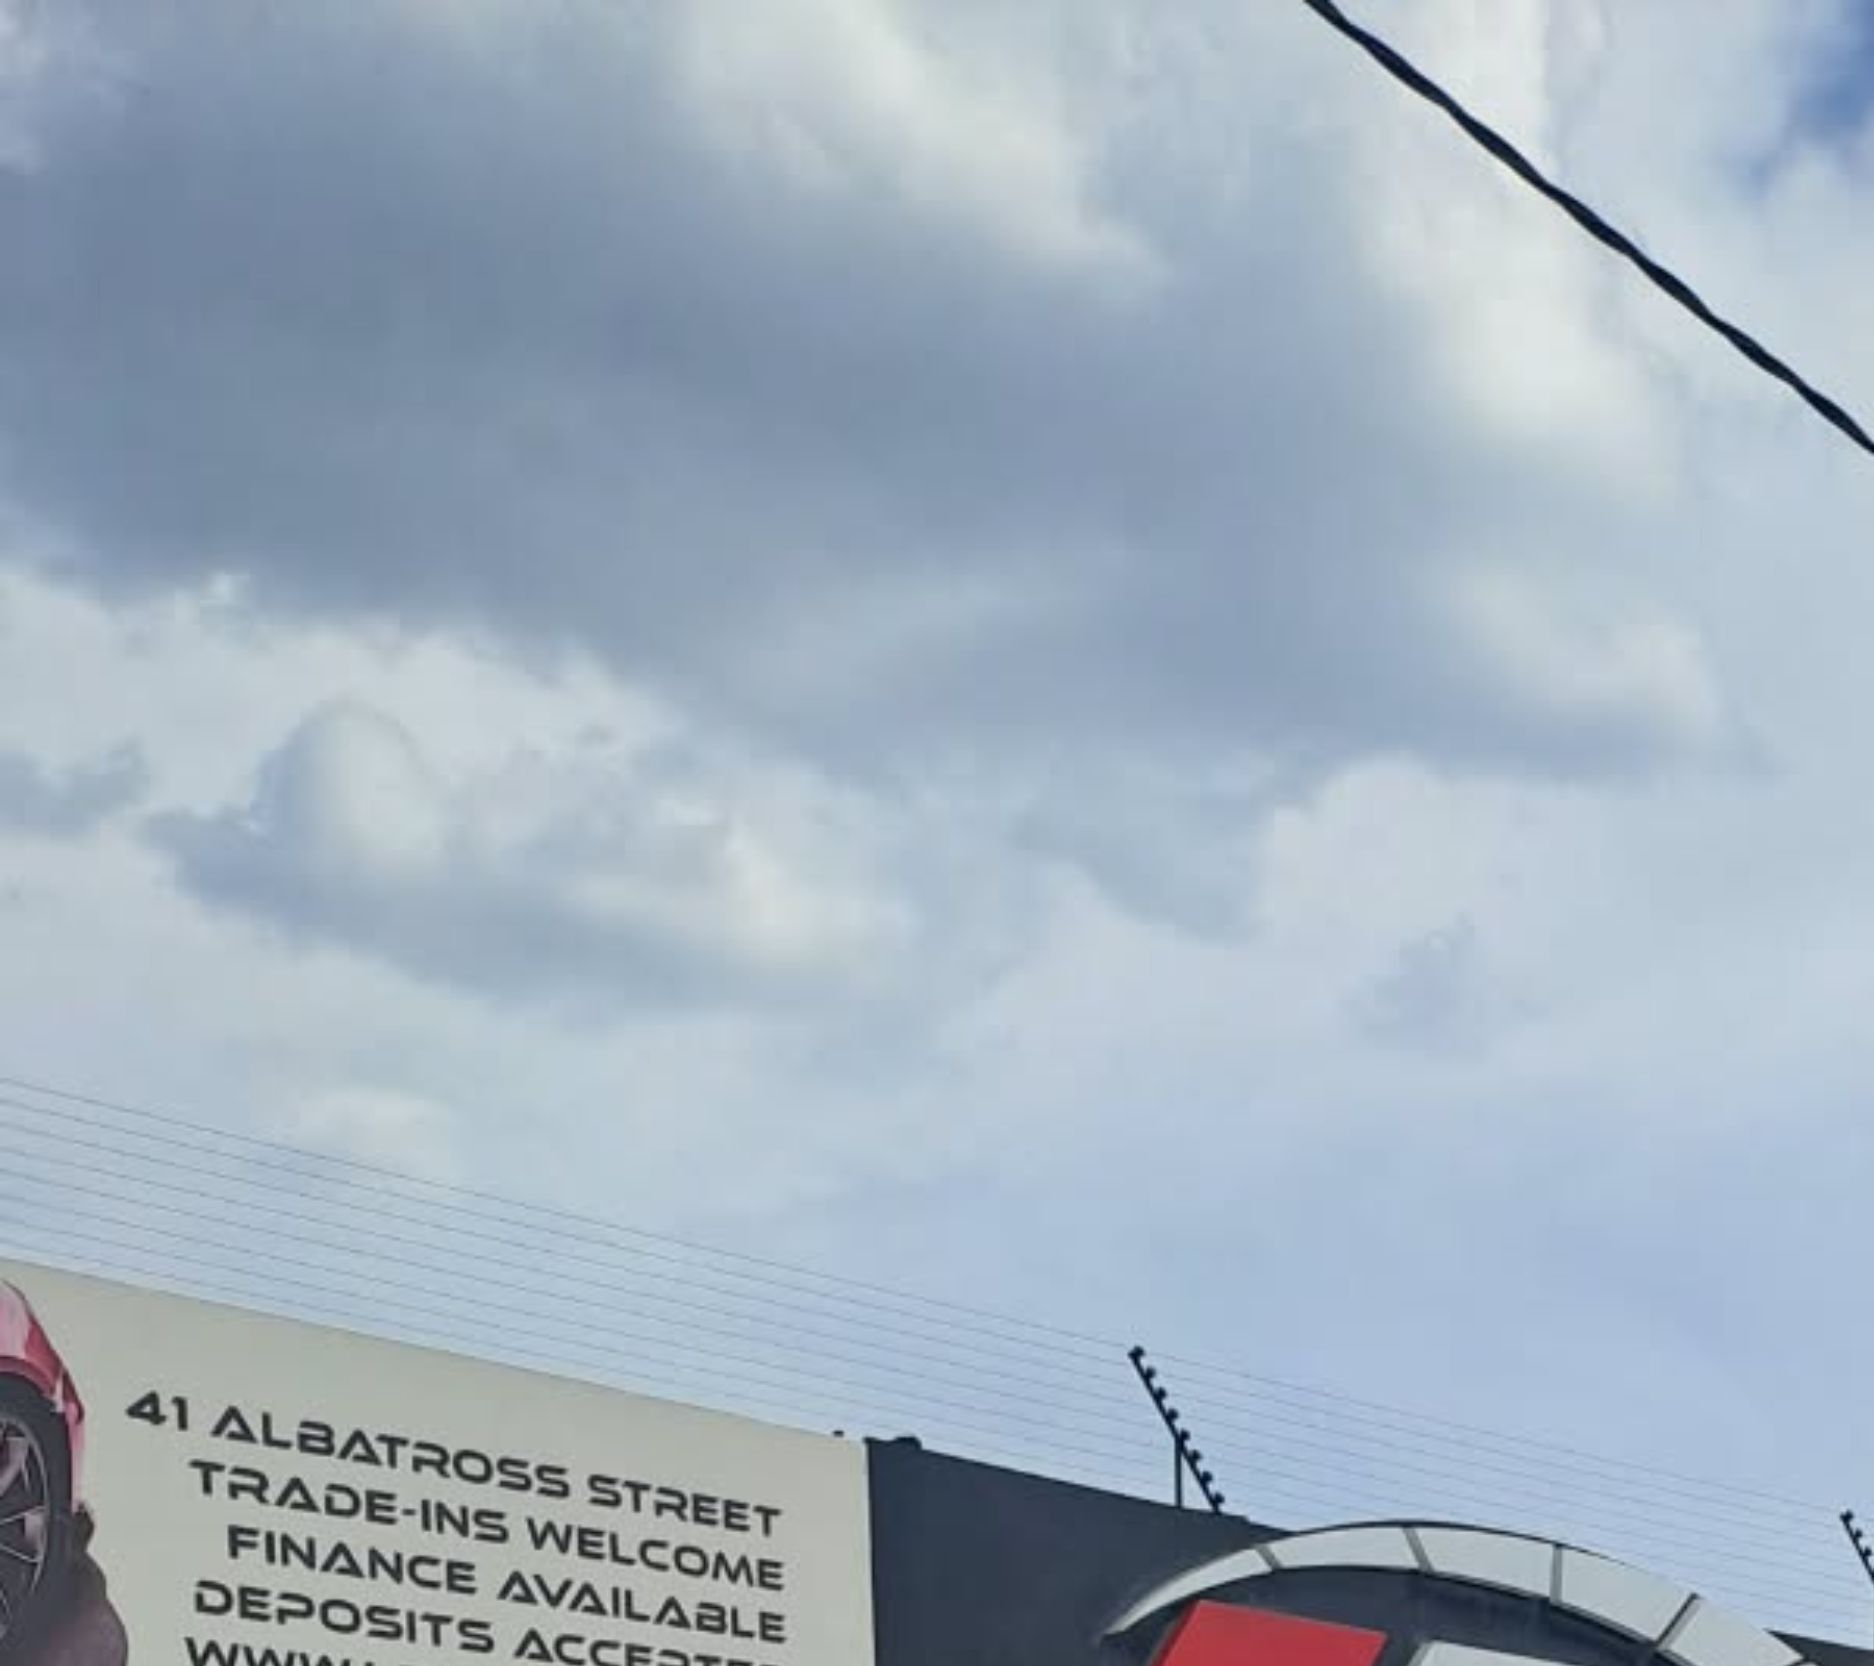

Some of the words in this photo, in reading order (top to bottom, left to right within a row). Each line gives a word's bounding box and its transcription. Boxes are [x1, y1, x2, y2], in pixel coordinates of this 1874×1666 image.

[127, 1391, 190, 1432] 41
[211, 1405, 570, 1499] ALBATROSS
[588, 1473, 782, 1538] STREET
[190, 1459, 509, 1544] TRADE-INS
[526, 1517, 784, 1591] WELCOME
[194, 1580, 494, 1653] DEPOSITS
[228, 1525, 477, 1594] FINANCE
[497, 1571, 787, 1645] AVAILABLE
